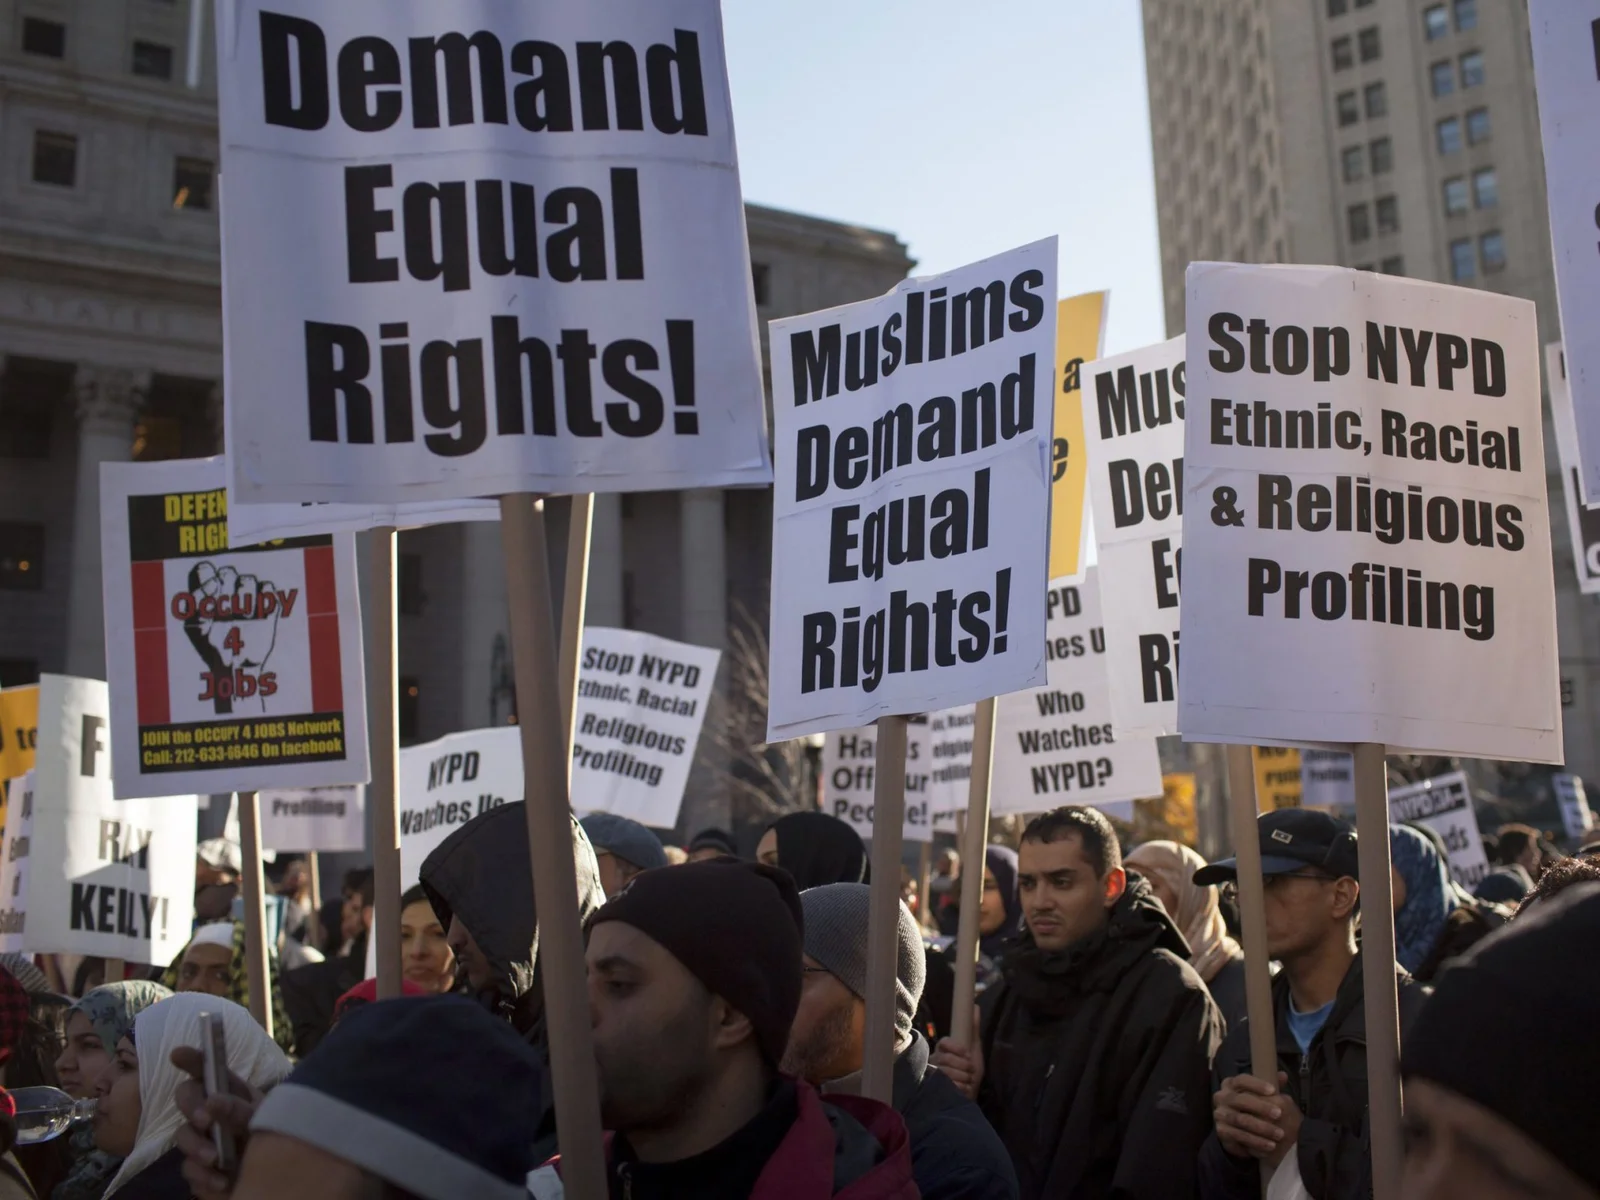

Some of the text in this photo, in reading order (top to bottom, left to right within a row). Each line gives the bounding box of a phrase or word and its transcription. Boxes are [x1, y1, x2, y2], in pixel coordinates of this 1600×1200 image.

[259, 10, 709, 137] Demand
[344, 164, 645, 292] Equal
[790, 269, 1045, 407] Muslims
[1207, 312, 1507, 398] Stop NYPD
[304, 315, 699, 457] Rights!
[795, 353, 1037, 502] Demand
[1210, 398, 1521, 472] Ethnic, Racial
[1108, 457, 1184, 528] De
[1210, 474, 1525, 552] & Religious
[828, 467, 991, 584] Equal
[1152, 538, 1182, 609] E
[1248, 557, 1495, 641] Profiling
[171, 588, 298, 621] Occupy
[801, 567, 1012, 694] Rights!
[223, 626, 245, 656] 4
[583, 647, 701, 689] Stop NYPD
[198, 668, 278, 701] Jobs
[636, 686, 697, 718] Racial
[1036, 690, 1085, 717] Who
[172, 729, 192, 745] the
[194, 726, 240, 743] OCCUPY
[242, 727, 251, 740] 4
[254, 723, 285, 739] JOBS
[580, 713, 686, 756] Religious
[838, 735, 921, 760] Has
[1018, 724, 1115, 755] Watches
[427, 751, 480, 792] NYPD
[832, 766, 874, 790] Off
[906, 774, 929, 793] ur
[1031, 757, 1113, 795] NYPD?
